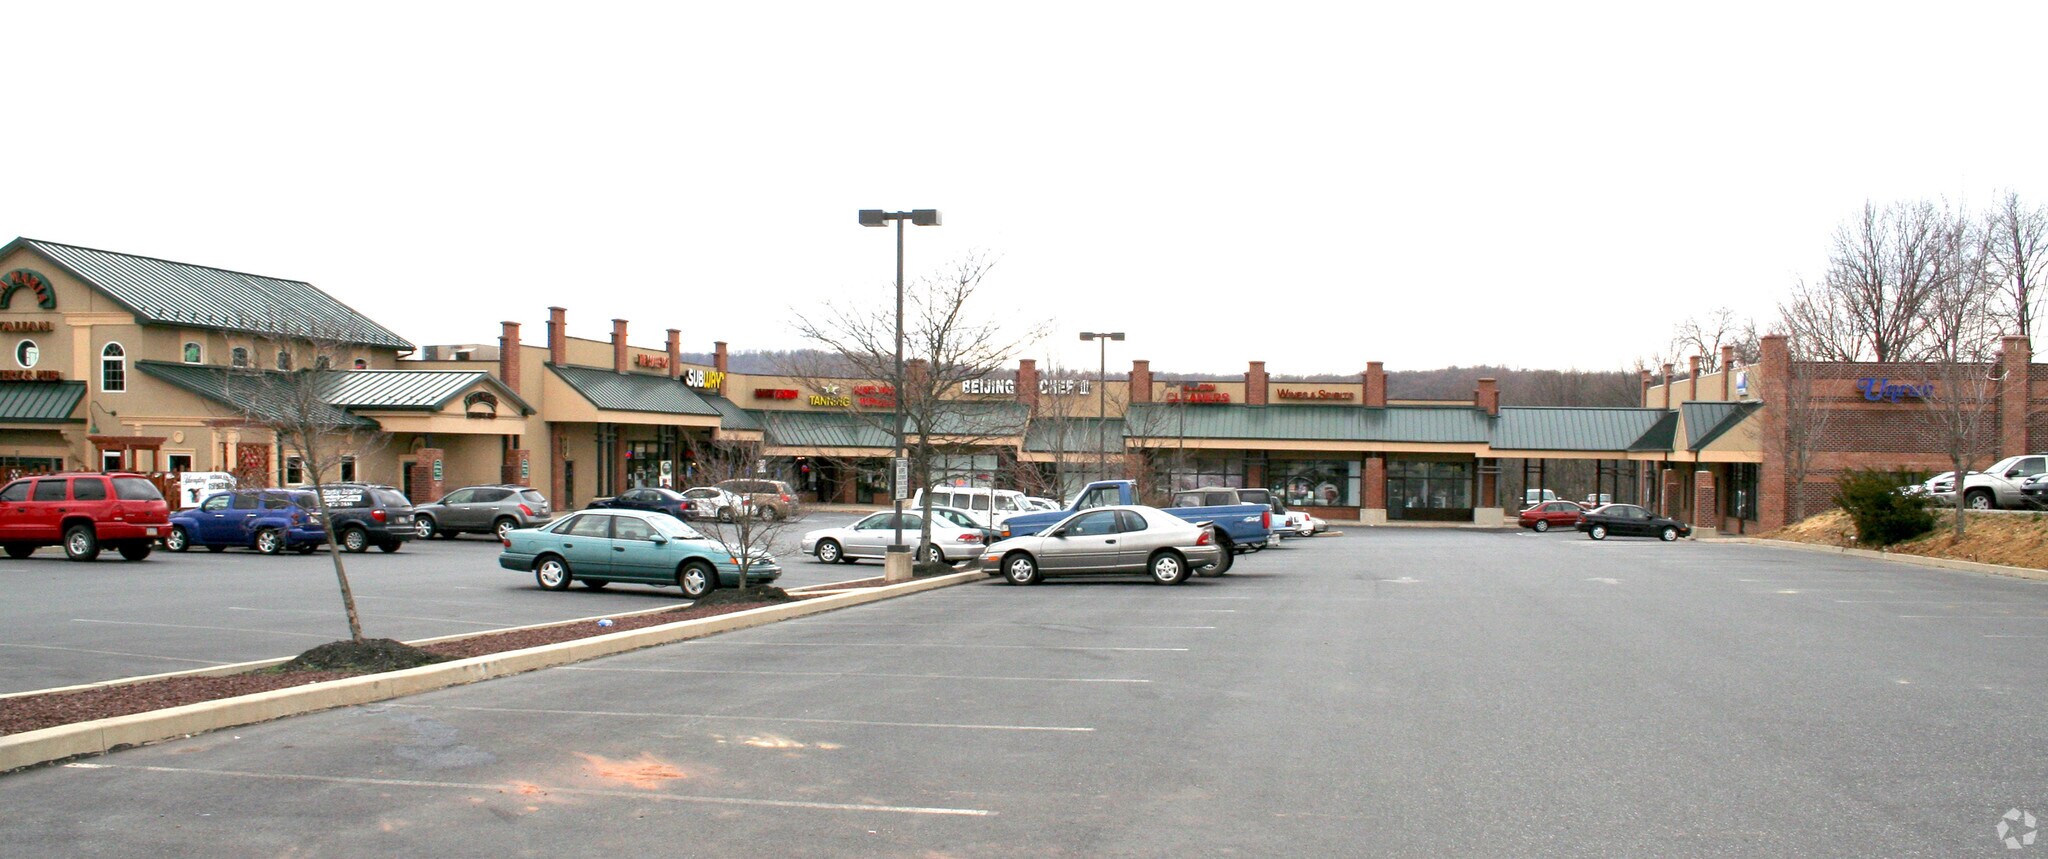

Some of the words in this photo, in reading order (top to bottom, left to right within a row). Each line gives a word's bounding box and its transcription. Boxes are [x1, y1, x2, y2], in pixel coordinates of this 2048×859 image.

[685, 368, 725, 389] SUBWAY
[961, 379, 1015, 394] BEIJING
[1039, 379, 1074, 395] CHEF
[1167, 392, 1230, 403] CLEANERS
